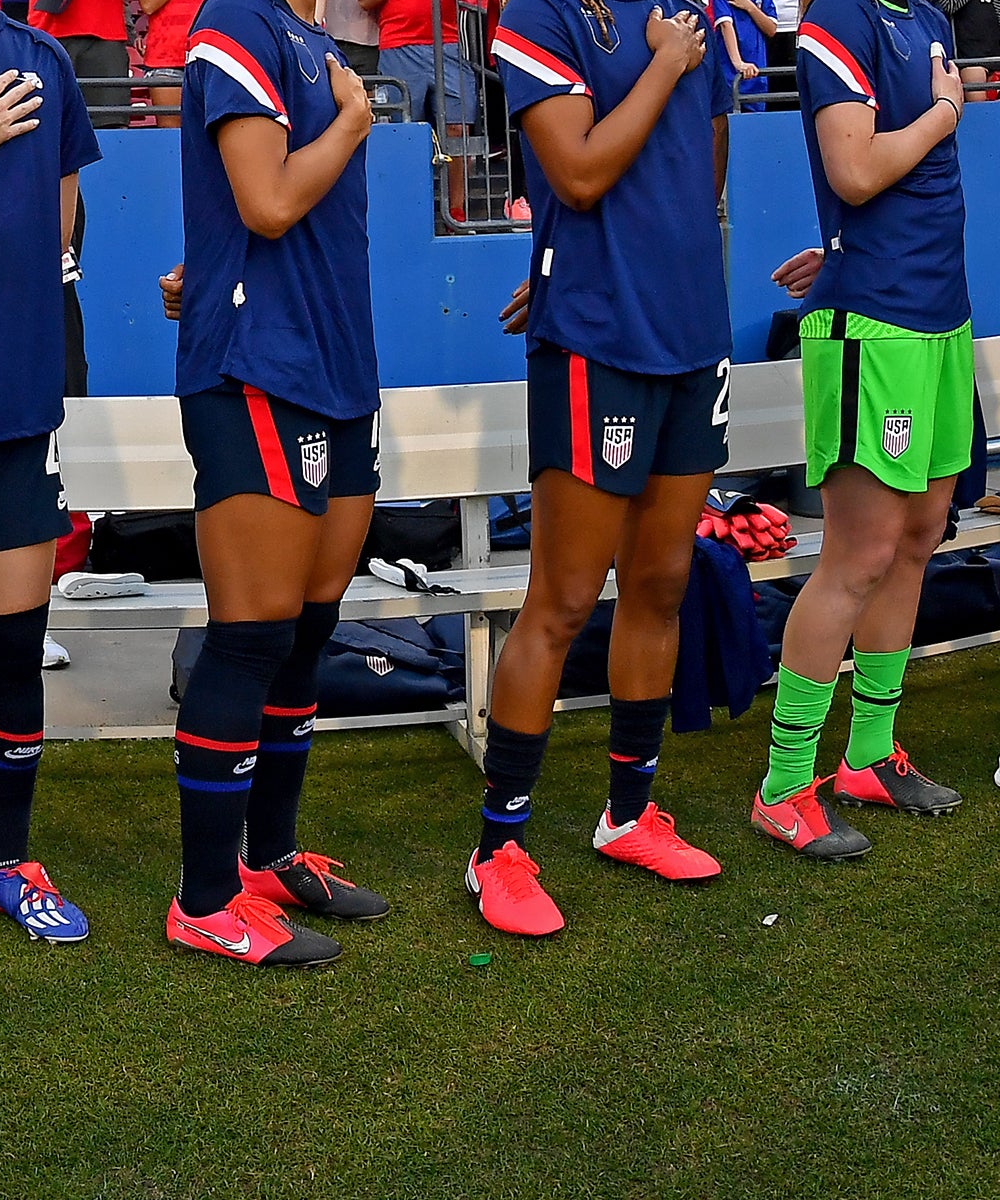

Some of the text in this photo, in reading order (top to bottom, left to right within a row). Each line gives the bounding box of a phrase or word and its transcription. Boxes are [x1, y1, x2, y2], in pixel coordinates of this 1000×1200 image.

[887, 419, 909, 435] USA
[606, 428, 632, 445] USA
[303, 444, 325, 462] USA
